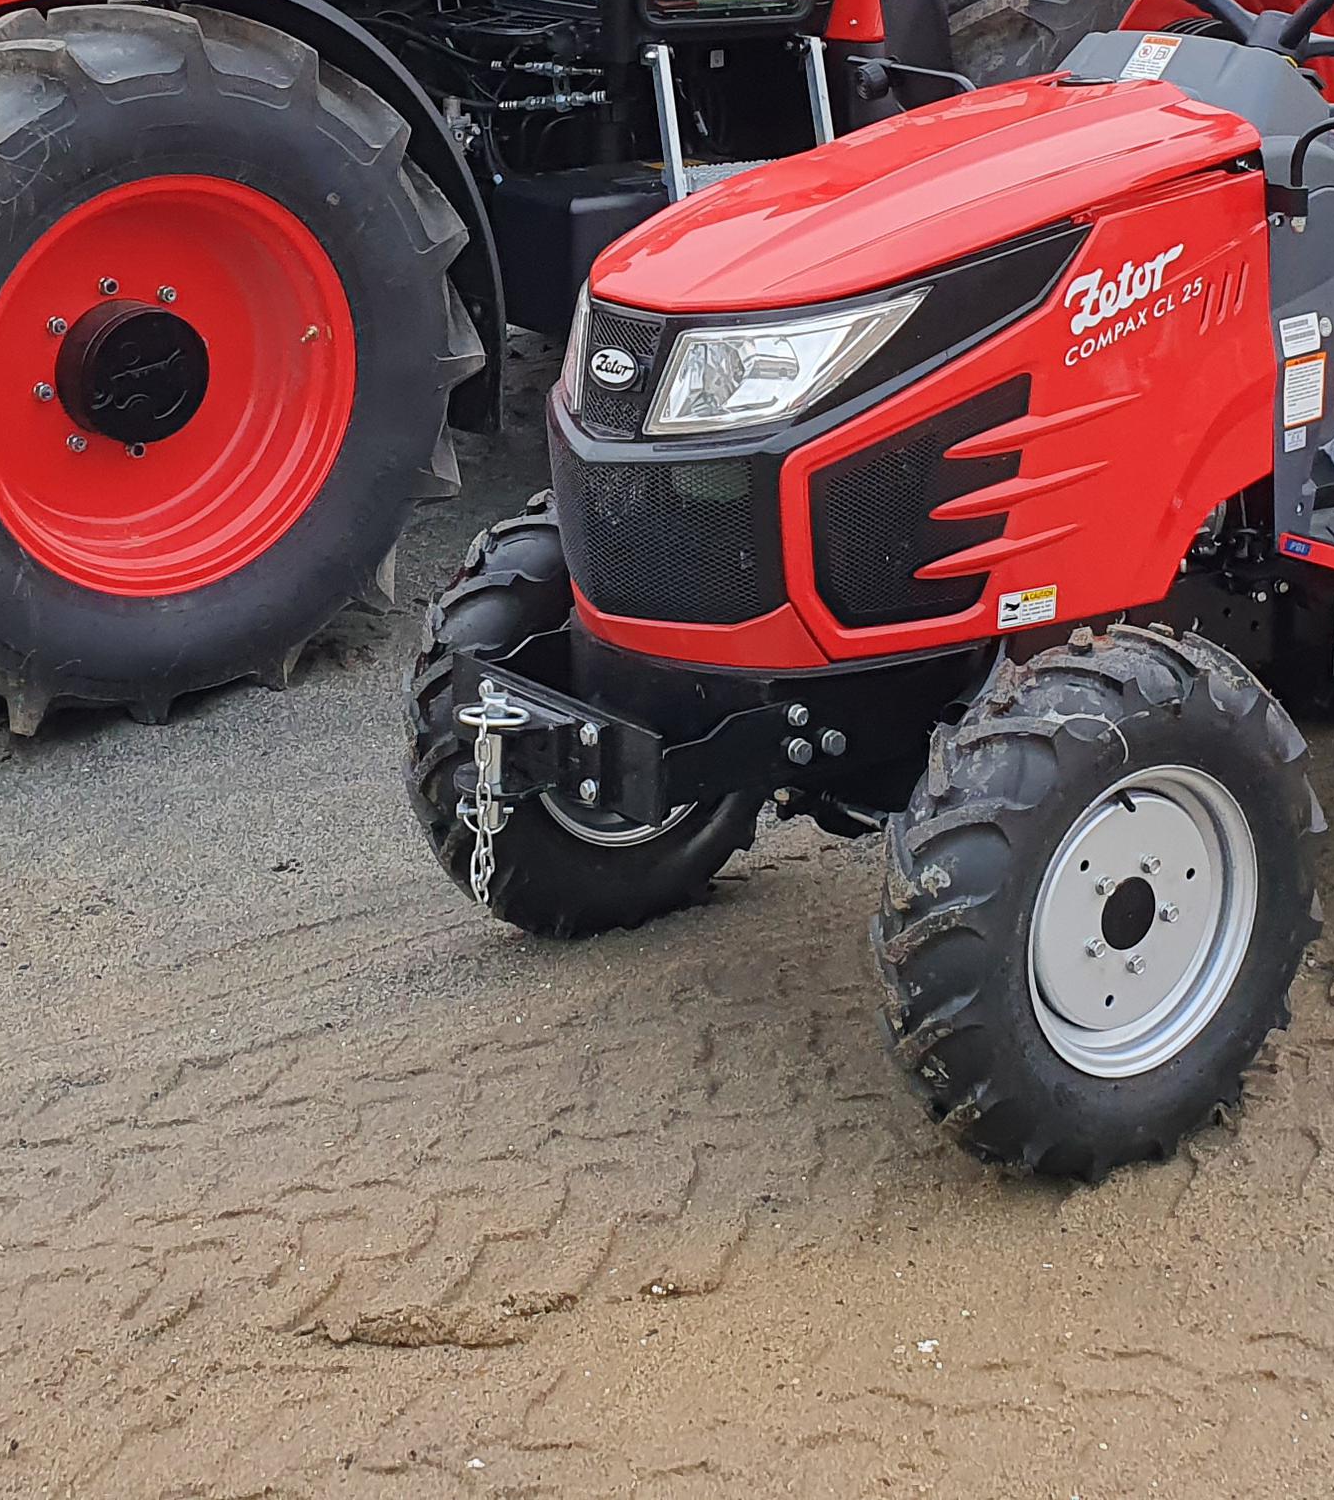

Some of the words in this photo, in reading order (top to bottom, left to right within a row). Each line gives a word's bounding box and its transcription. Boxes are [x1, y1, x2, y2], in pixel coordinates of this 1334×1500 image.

[1064, 243, 1184, 335] Zetor
[1064, 307, 1148, 366] COMPAX
[1153, 294, 1175, 318] CL
[1181, 277, 1203, 304] 25
[596, 353, 635, 377] Zetor
